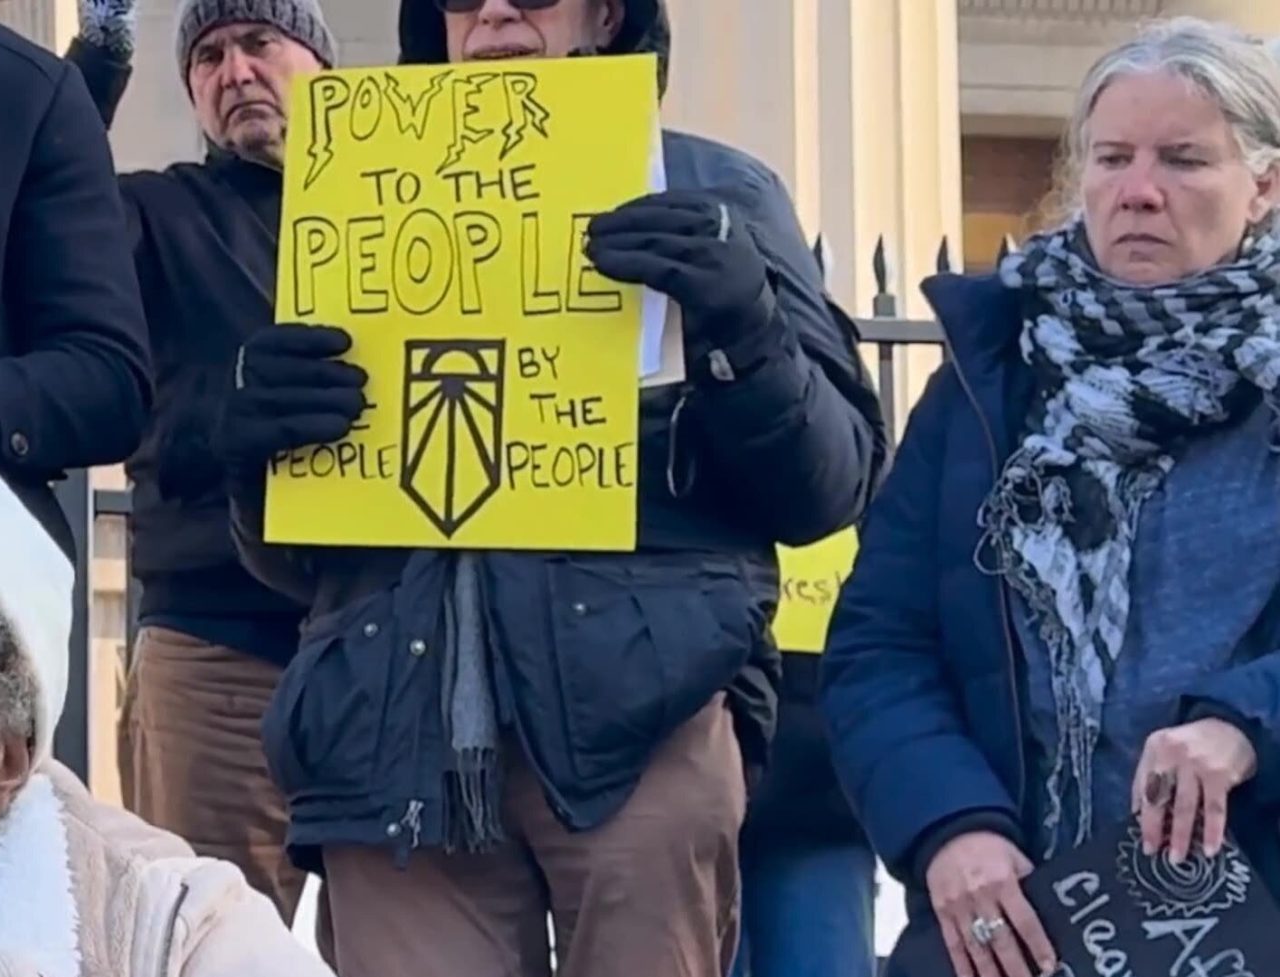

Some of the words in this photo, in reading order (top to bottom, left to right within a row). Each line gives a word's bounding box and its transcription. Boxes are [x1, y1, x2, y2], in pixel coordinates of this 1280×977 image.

[303, 68, 551, 191] POWER
[359, 167, 421, 206] TO
[441, 163, 541, 204] THE
[292, 207, 624, 317] PEOPLE
[517, 345, 562, 381] BY
[528, 391, 608, 429] THE
[505, 440, 635, 491] PEOPLE
